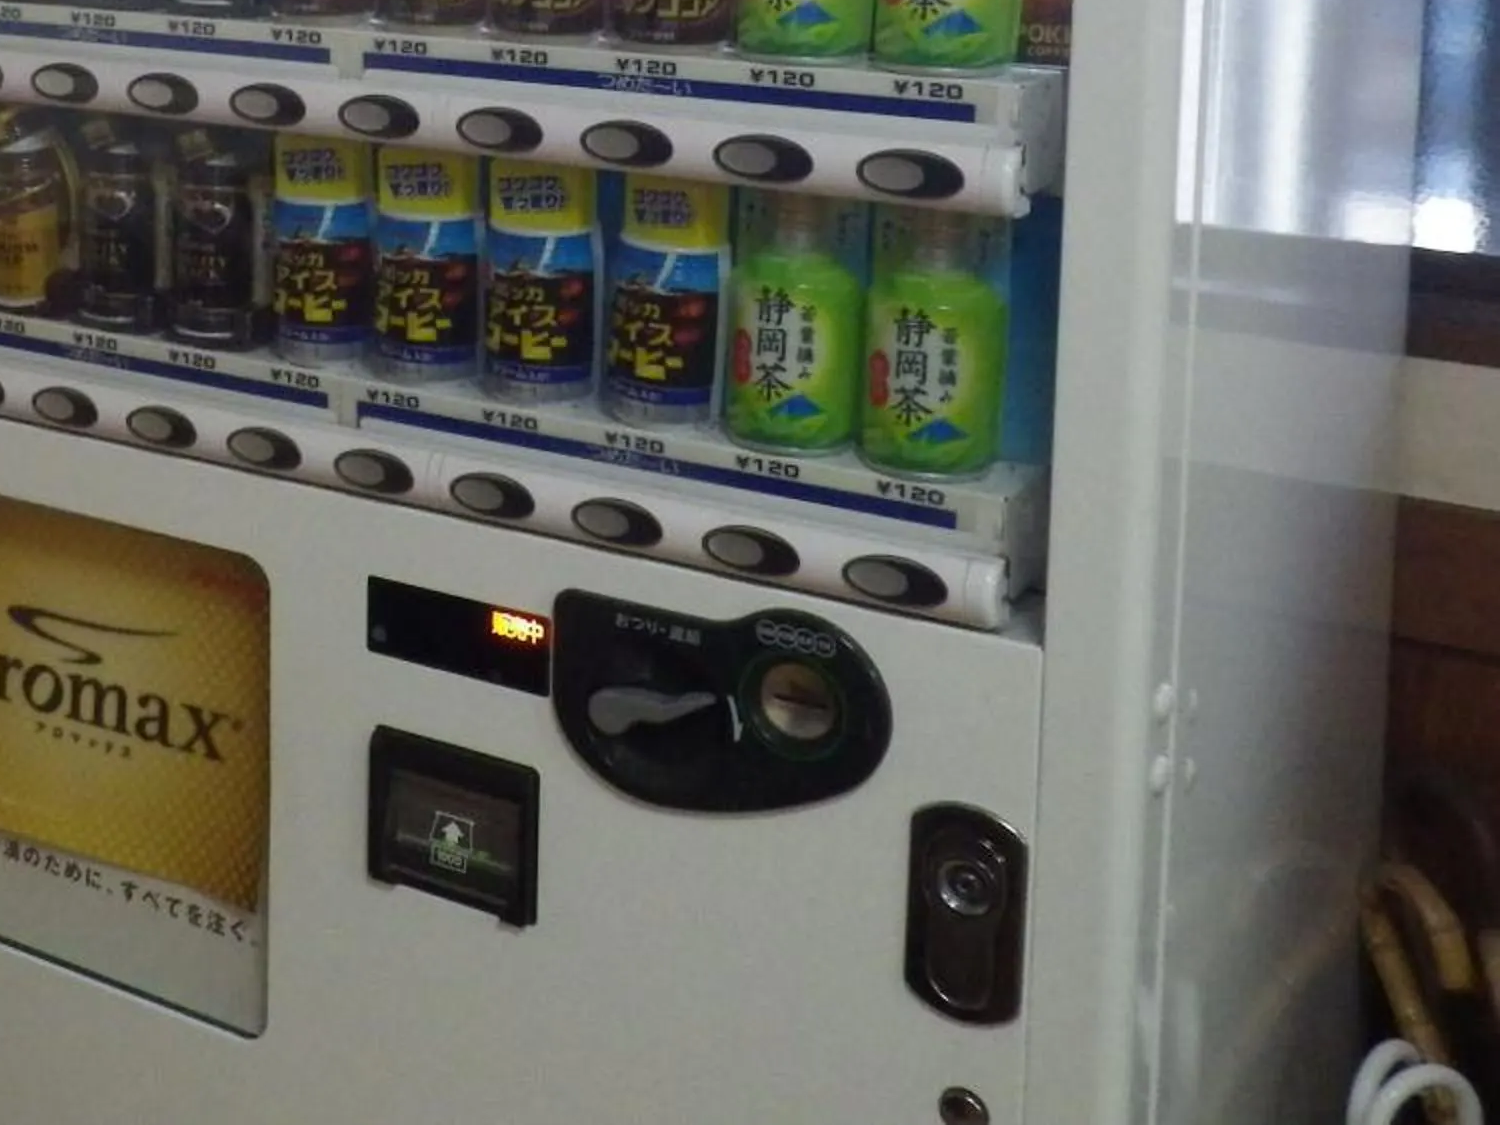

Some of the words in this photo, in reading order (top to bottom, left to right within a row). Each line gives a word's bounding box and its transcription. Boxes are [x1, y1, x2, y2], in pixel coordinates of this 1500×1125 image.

[270, 27, 322, 44] ¥120
[373, 38, 428, 56] ¥120
[491, 47, 549, 66] ¥120
[615, 57, 677, 76] ¥120
[750, 69, 815, 88] ¥120
[893, 80, 964, 100] ¥120
[754, 286, 795, 401] 静岡茶
[269, 368, 320, 389] ¥120
[892, 308, 936, 428] 静岡茶
[367, 388, 421, 410] ¥120
[482, 409, 539, 431] ¥120
[604, 431, 665, 455] ¥120
[735, 454, 801, 478] ¥120
[877, 480, 945, 506] ¥120
